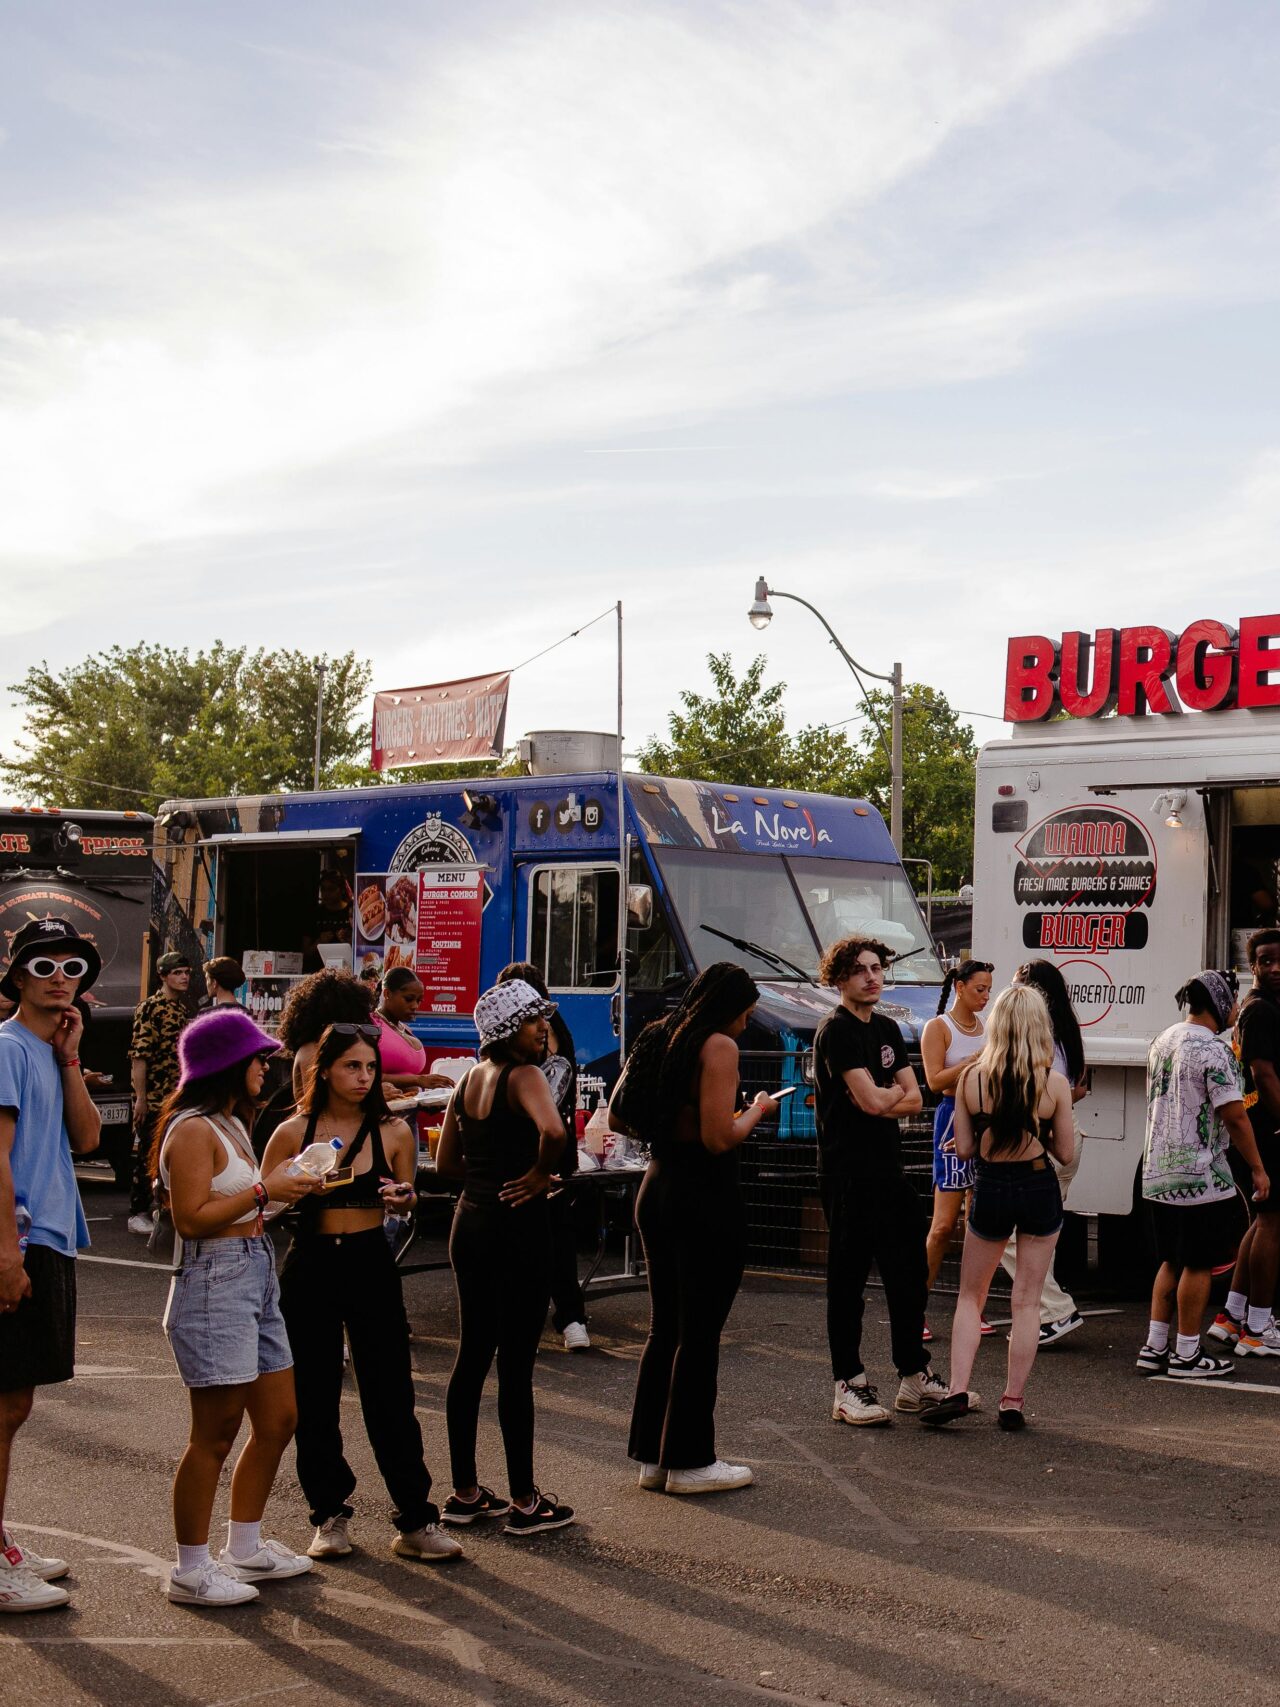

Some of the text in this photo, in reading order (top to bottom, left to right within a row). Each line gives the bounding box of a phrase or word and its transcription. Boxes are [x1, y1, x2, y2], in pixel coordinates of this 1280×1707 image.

[711, 807, 833, 848] La Novela
[79, 836, 148, 856] TRUCK
[1044, 821, 1127, 855] WANNA
[437, 873, 466, 882] MENU
[1018, 876, 1152, 891] FRESH MADE BURGERS & SHAKES
[422, 891, 478, 899] BURGER COMBOS
[1040, 914, 1126, 954] BURGER
[245, 992, 282, 1010] Fusion
[431, 1004, 456, 1012] WATER
